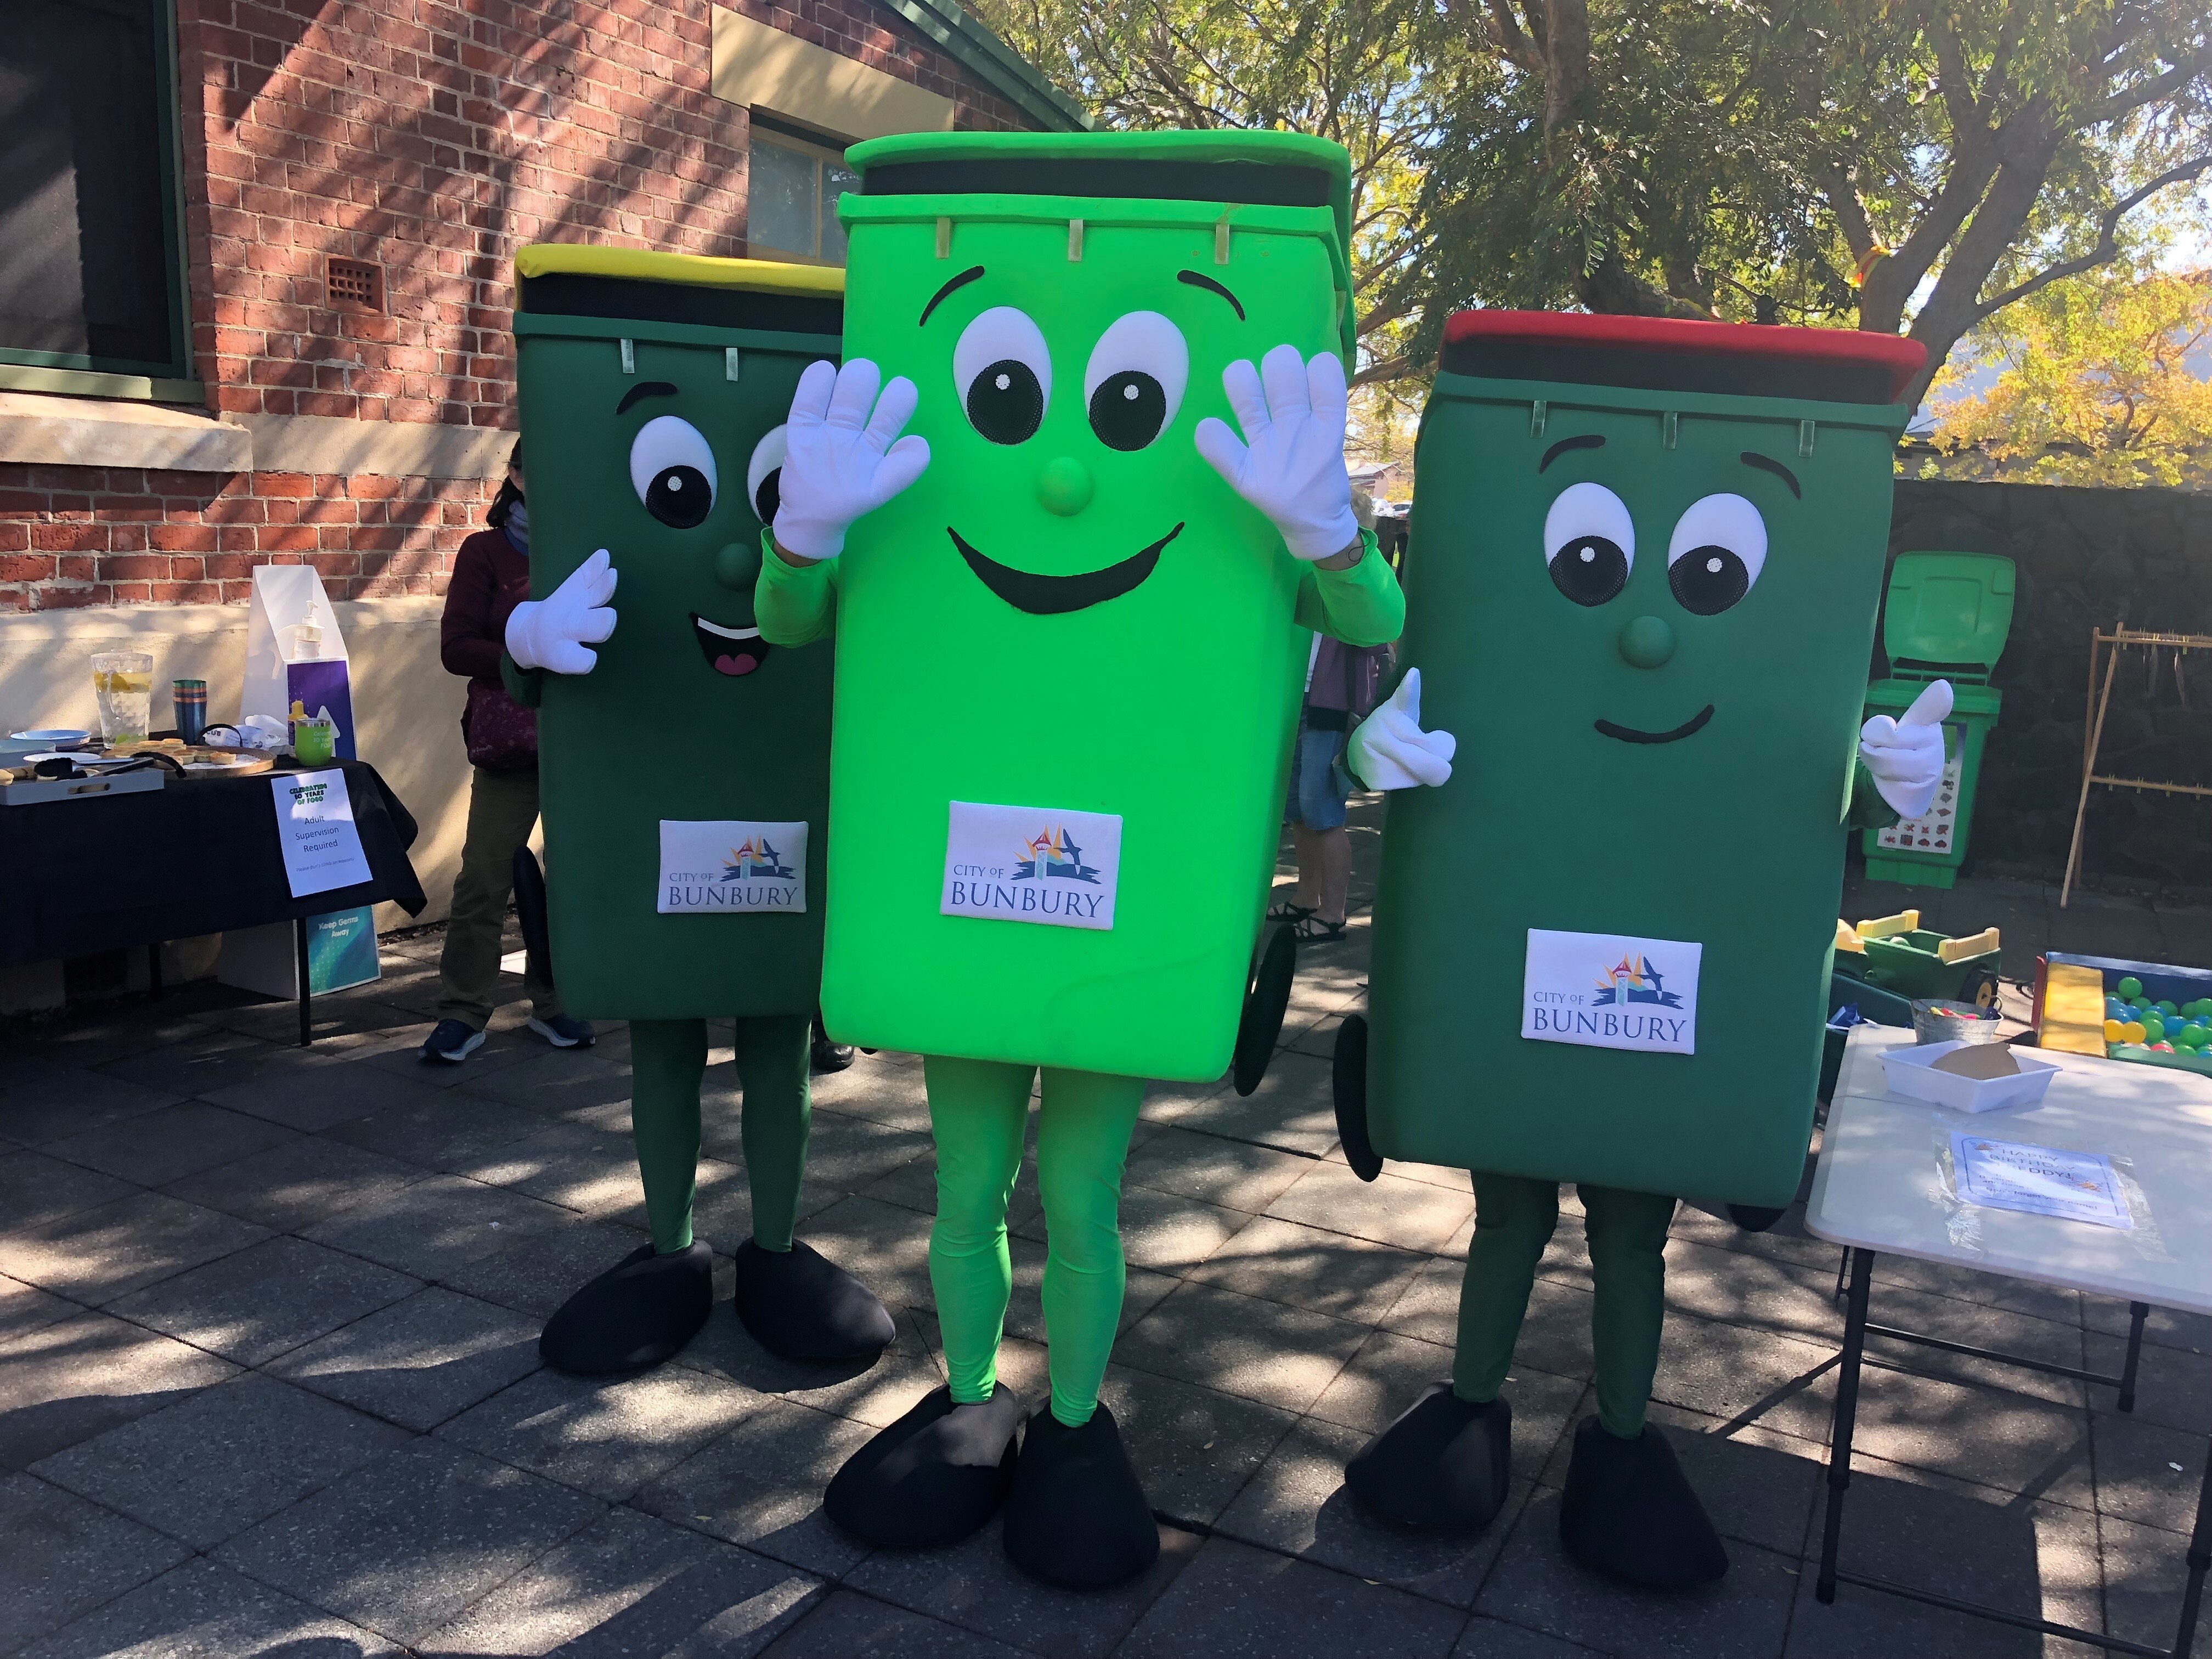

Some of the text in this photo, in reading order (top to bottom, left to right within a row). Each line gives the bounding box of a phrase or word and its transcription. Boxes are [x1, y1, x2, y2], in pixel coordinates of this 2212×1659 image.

[304, 789, 324, 798] YEARS
[304, 815, 325, 825] Adult
[295, 827, 340, 840] Supervision
[303, 839, 338, 853] Required
[669, 873, 714, 882] CITY OF
[953, 865, 1004, 878] CITY OF
[669, 887, 798, 905] BUNBURY
[951, 881, 1104, 918] BUNBURY
[318, 917, 359, 930] Keep Germs
[331, 929, 349, 937] Away
[1533, 991, 1584, 1005] CITY OF
[1532, 1007, 1687, 1042] BUNBURY
[2003, 1149, 2058, 1161] HAPPY
[1990, 1154, 2075, 1170] BIRTHDAY
